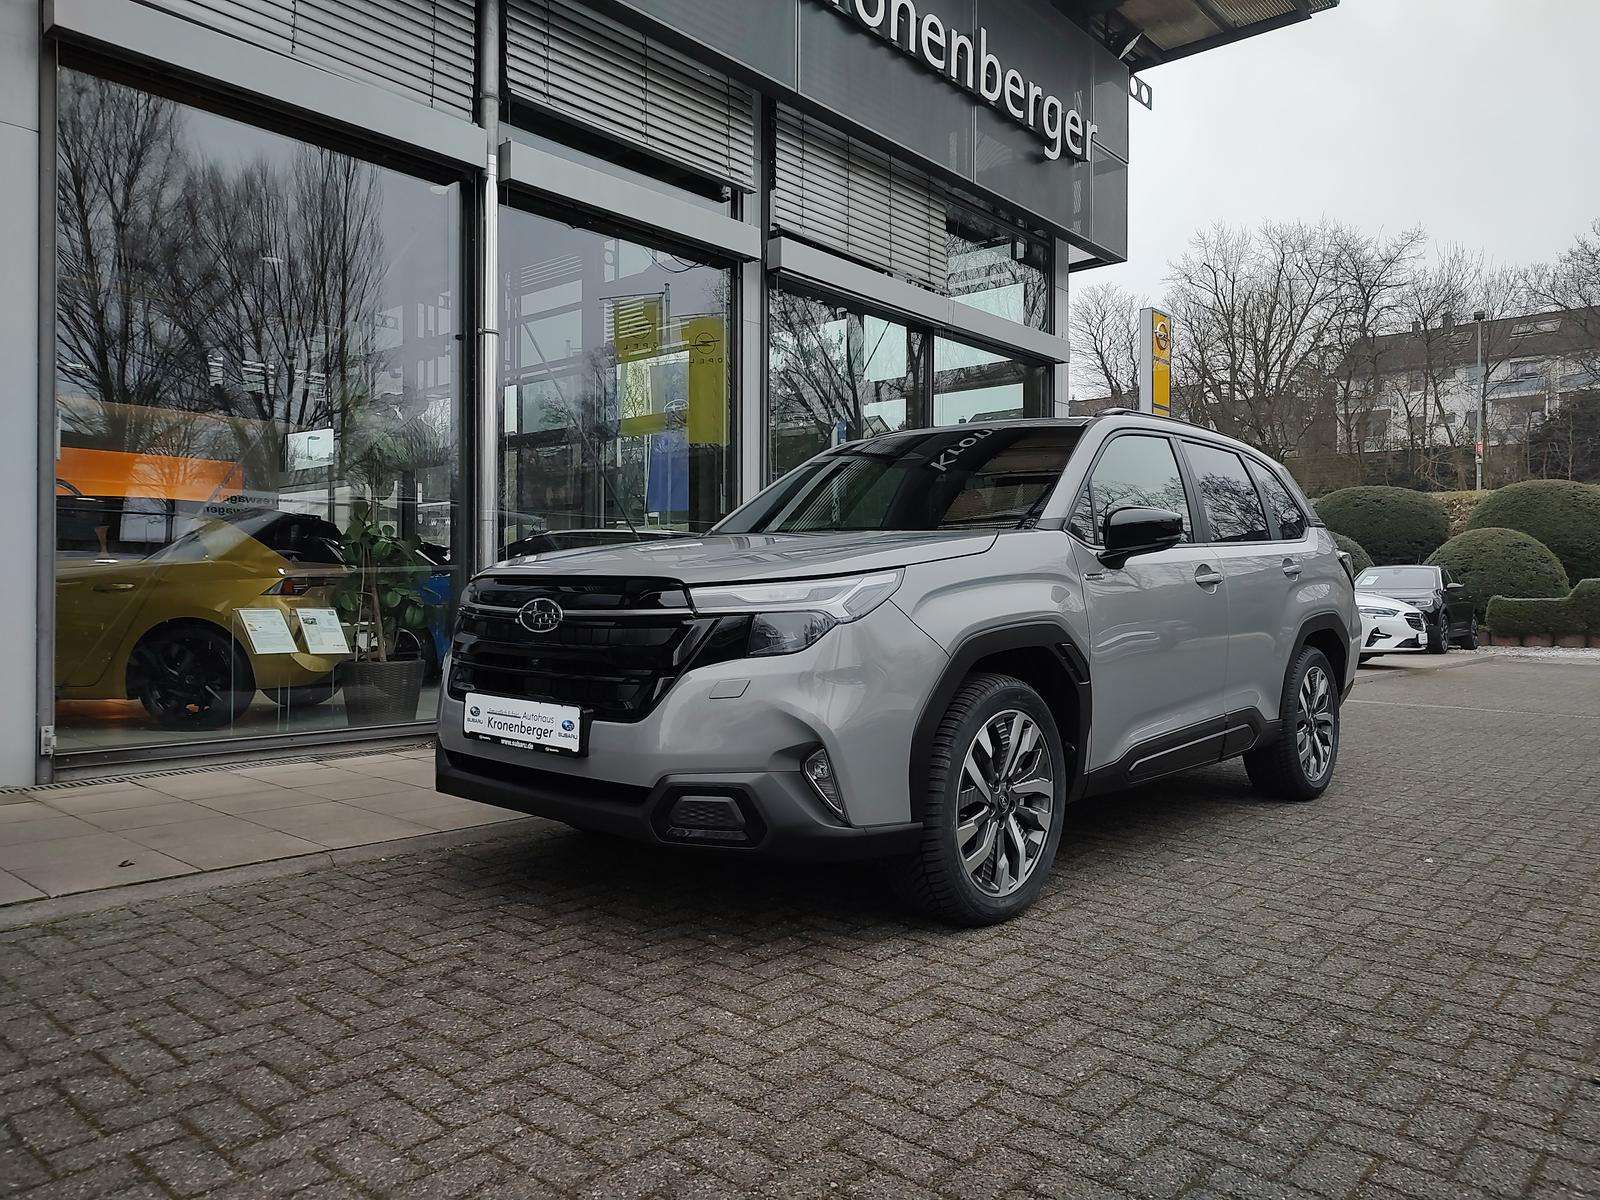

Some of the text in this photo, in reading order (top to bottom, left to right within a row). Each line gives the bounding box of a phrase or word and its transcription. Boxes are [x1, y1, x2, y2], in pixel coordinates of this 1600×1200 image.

[831, 0, 1098, 161] onenberger
[466, 717, 484, 725] SUBARU
[521, 711, 555, 724] Autohaus
[487, 716, 554, 739] Kronenberger
[557, 731, 578, 740] SUBARU
